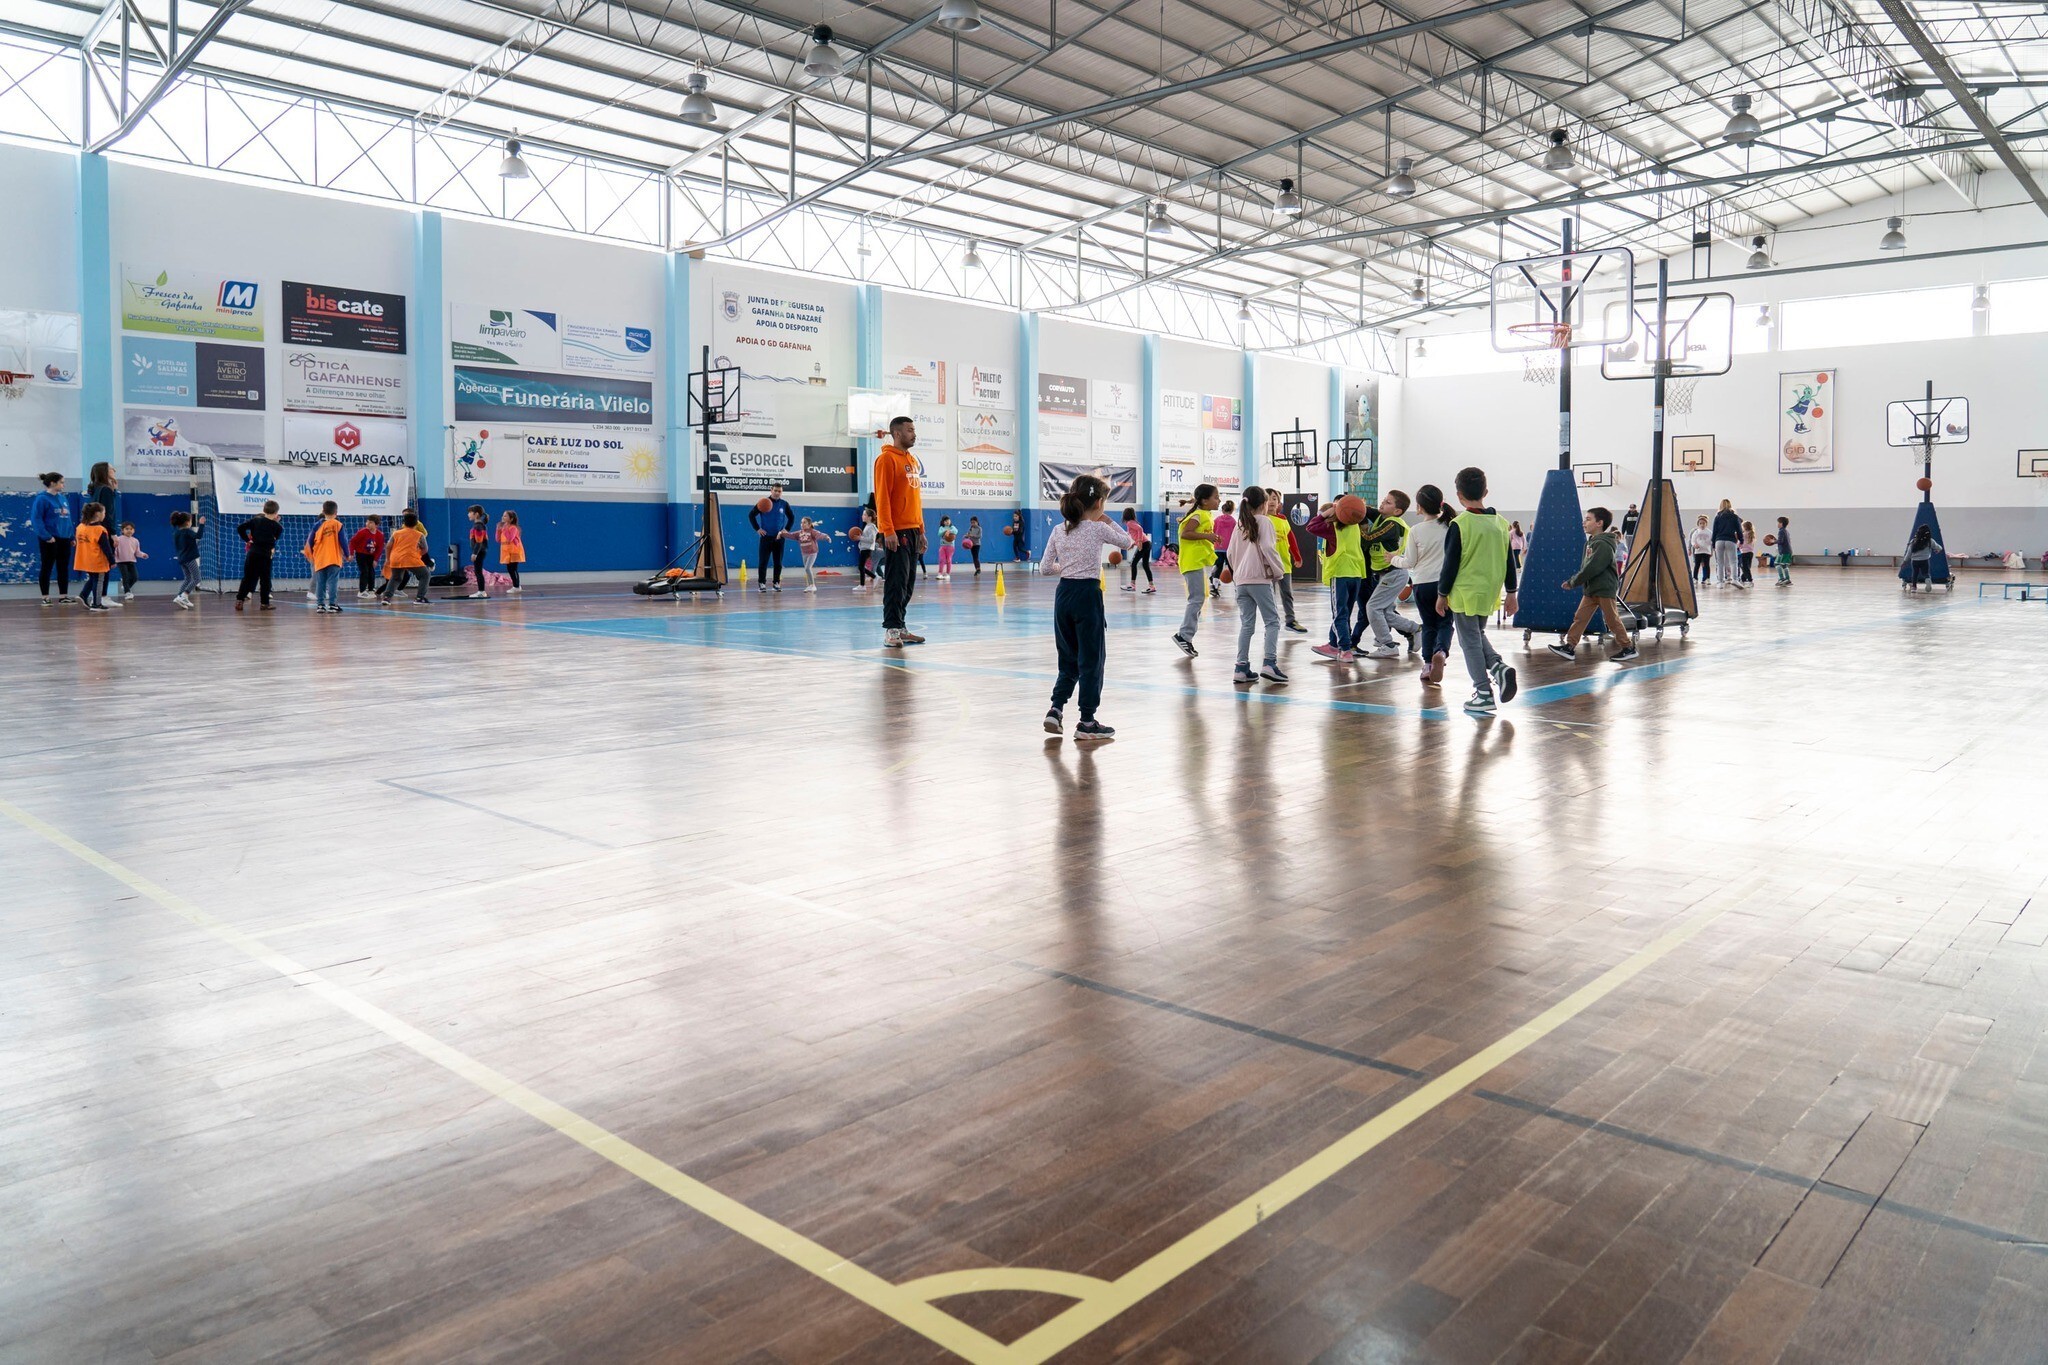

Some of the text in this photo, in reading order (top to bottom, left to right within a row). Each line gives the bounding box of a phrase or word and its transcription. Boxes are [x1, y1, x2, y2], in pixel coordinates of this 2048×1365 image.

[142, 287, 194, 300] Frescos da
[161, 299, 202, 311] Gafanha
[306, 287, 384, 316] biscate
[747, 295, 769, 306] JUNTA
[780, 300, 815, 311] FEGUESIA
[815, 305, 825, 313] DA
[751, 307, 785, 318] GAFANHA
[796, 312, 822, 324] NAZARÉ
[479, 324, 526, 339] limpaveiro
[756, 319, 777, 329] APOIA
[785, 323, 819, 334] DESPORTO
[736, 336, 759, 345] APOIA
[767, 339, 778, 347] GD
[779, 340, 812, 352] GAFANHA
[157, 365, 188, 373] SALINAS
[217, 366, 247, 376] AVEIRO
[972, 366, 1002, 384] ATHLETIC
[308, 371, 401, 388] GAFANHENSE
[312, 387, 345, 397] Diferença
[458, 382, 650, 414] Agência Funerária Vilelo
[973, 382, 1001, 399] FACTORY
[1163, 395, 1195, 409] ATITUDE
[528, 435, 624, 450] CAFÉ LUZ DO SOL
[136, 448, 188, 457] MARISAL
[288, 449, 405, 466] MÓVEIS MARGAÇA
[536, 447, 563, 456] Alexandre
[547, 460, 557, 468] de
[558, 461, 589, 469] Petiscos
[730, 452, 793, 467] ESPORGEL
[962, 457, 1012, 474] salpetra.pt
[807, 466, 846, 474] CIVILRIA
[1170, 469, 1183, 482] PR
[722, 477, 749, 486] Portugal
[750, 478, 763, 486] para
[769, 478, 790, 486] Mundo
[928, 481, 945, 489] REAIS
